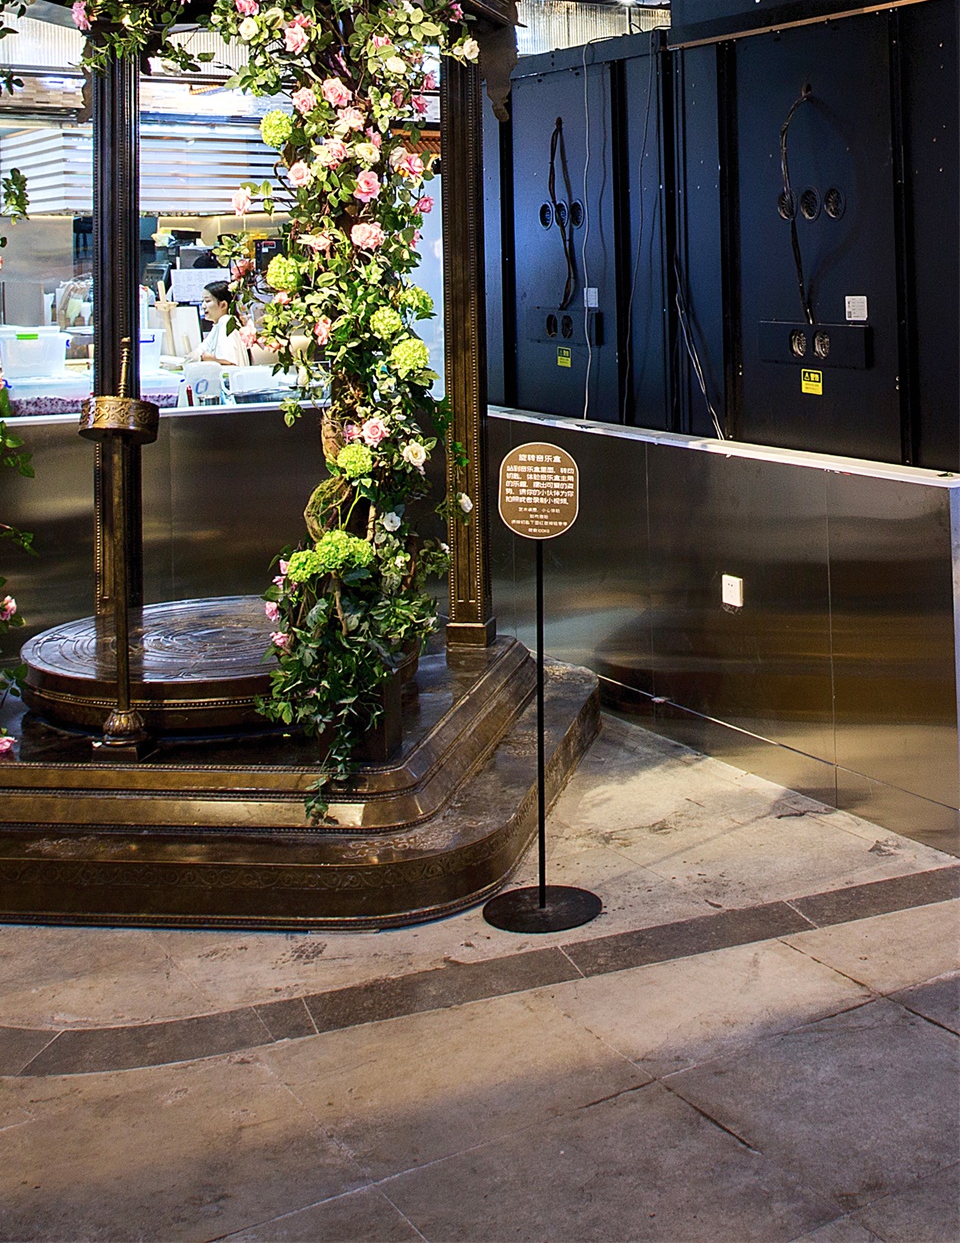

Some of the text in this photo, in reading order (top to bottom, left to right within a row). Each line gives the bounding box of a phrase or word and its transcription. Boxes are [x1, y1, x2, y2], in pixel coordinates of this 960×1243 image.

[518, 454, 561, 463] 旋转音乐盒
